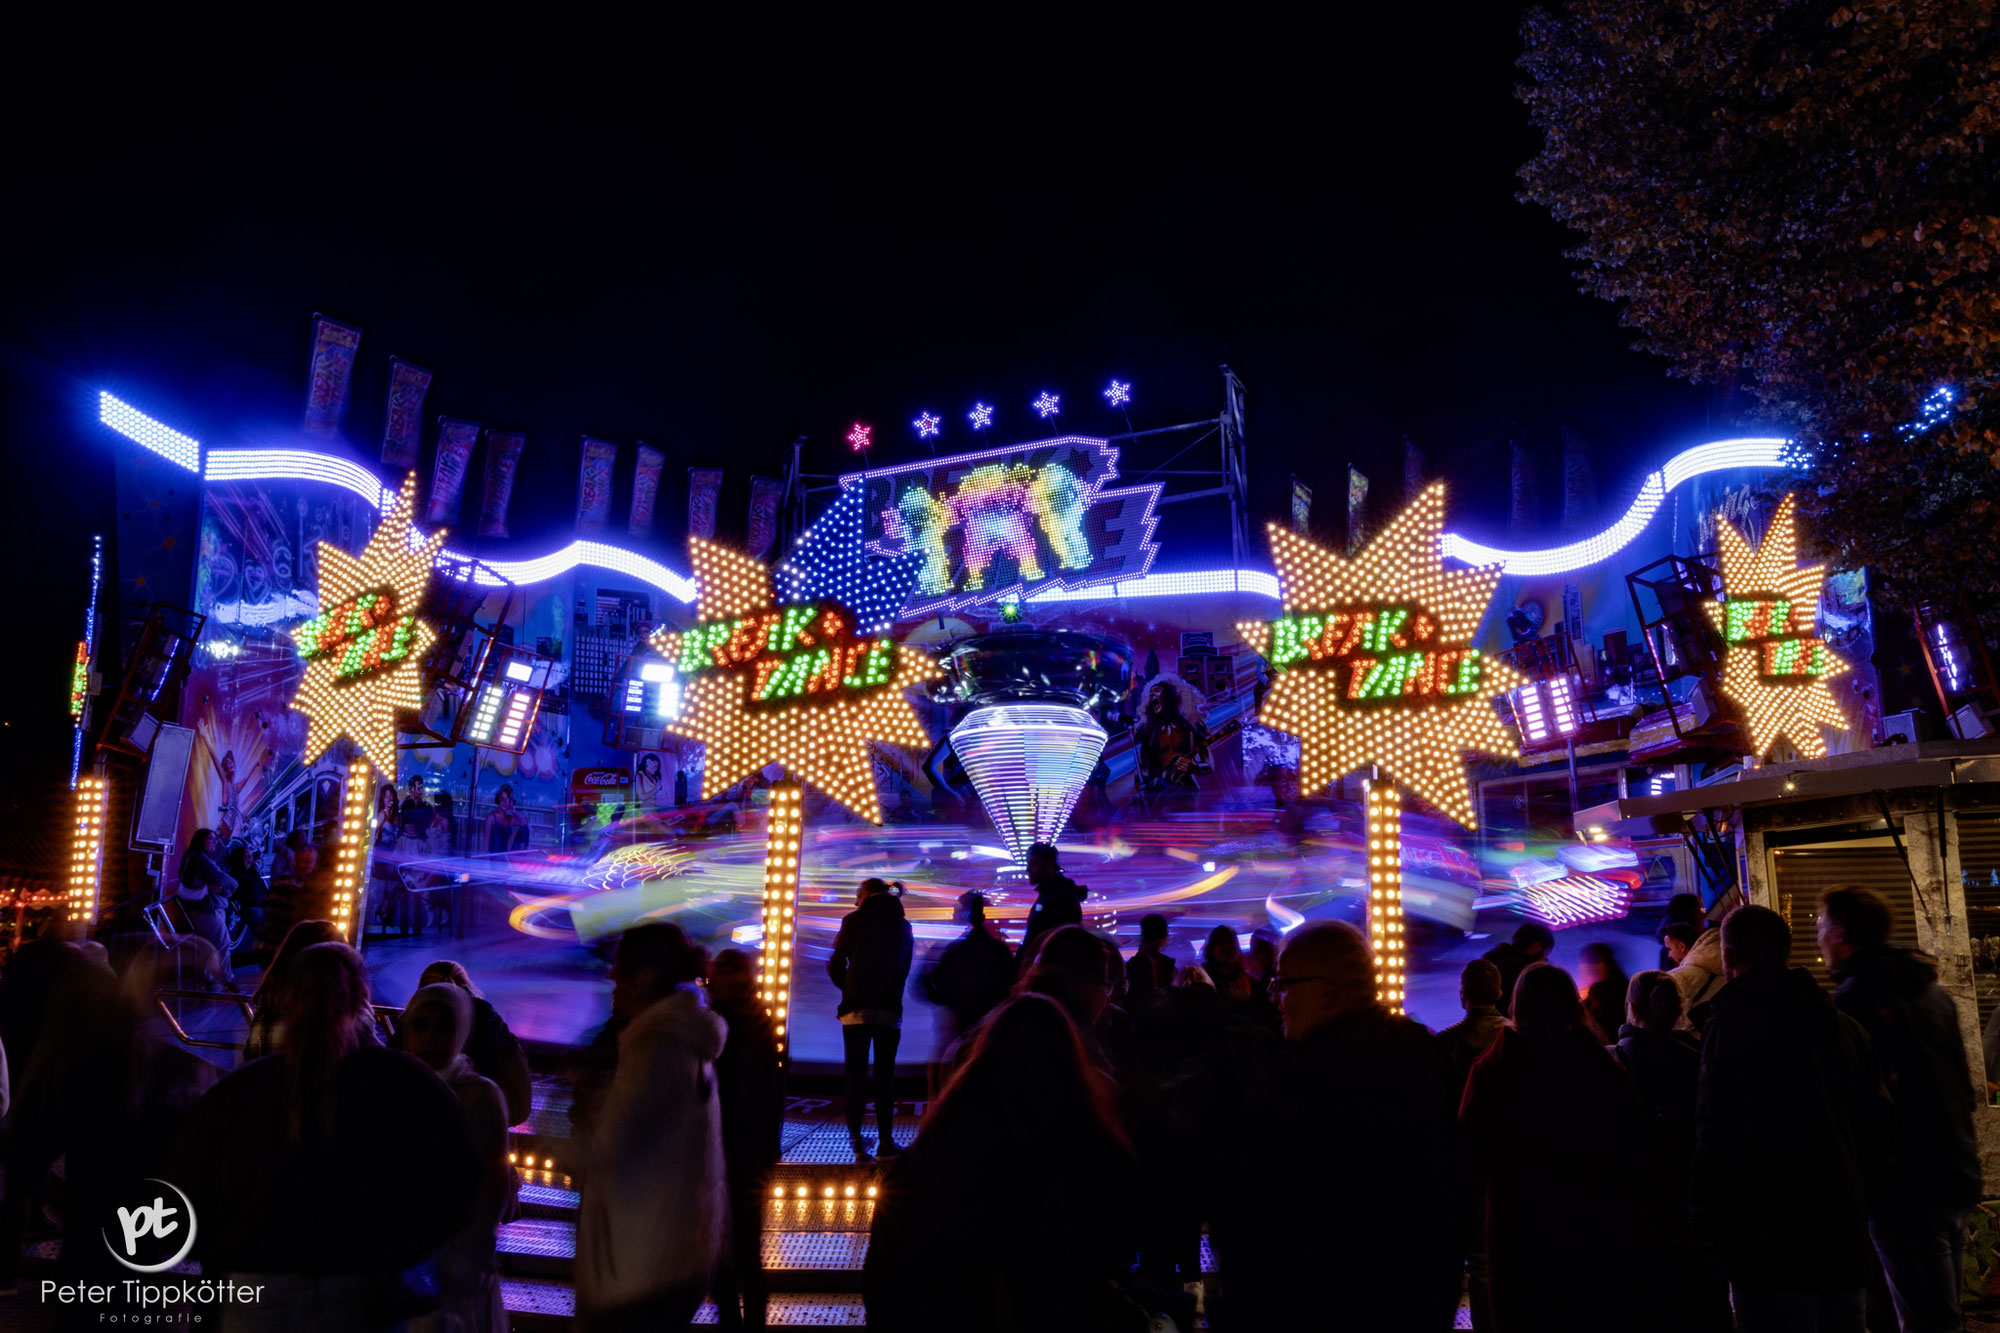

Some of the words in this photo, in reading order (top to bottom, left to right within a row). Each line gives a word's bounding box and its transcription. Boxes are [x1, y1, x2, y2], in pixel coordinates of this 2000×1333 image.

[678, 606, 817, 673] BREAK
[1272, 609, 1408, 664] BREAK
[752, 639, 892, 700] DANCE
[1346, 648, 1480, 699] DANCE
